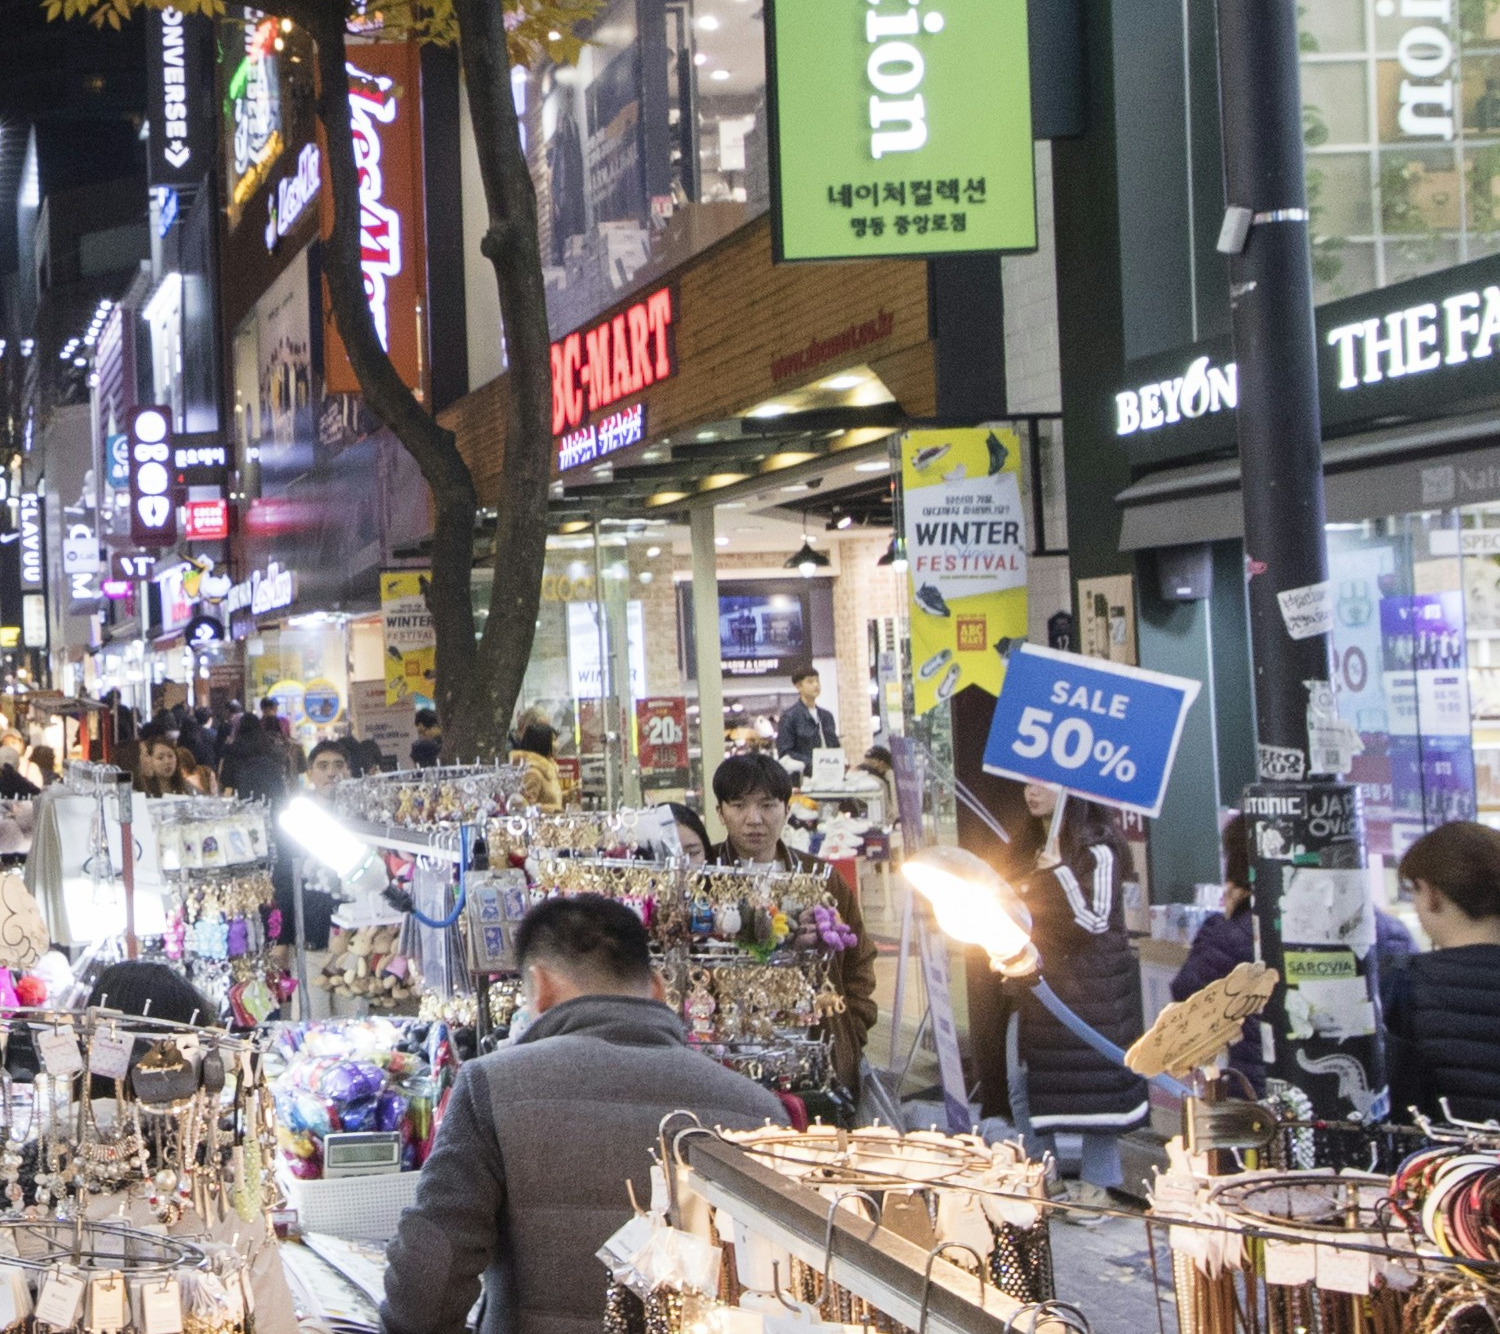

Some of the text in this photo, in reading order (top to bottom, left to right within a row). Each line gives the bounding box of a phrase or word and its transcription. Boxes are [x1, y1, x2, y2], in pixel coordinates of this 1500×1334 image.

[161, 5, 187, 138] ONVERSE
[551, 286, 672, 437] BC-MART
[1115, 356, 1238, 436] BEYON
[20, 492, 42, 583] KLAVUU
[915, 521, 1019, 547] WINTER
[916, 554, 1020, 572] FESTIVAL
[1050, 680, 1129, 722] SALE
[1011, 705, 1138, 784] 50%
